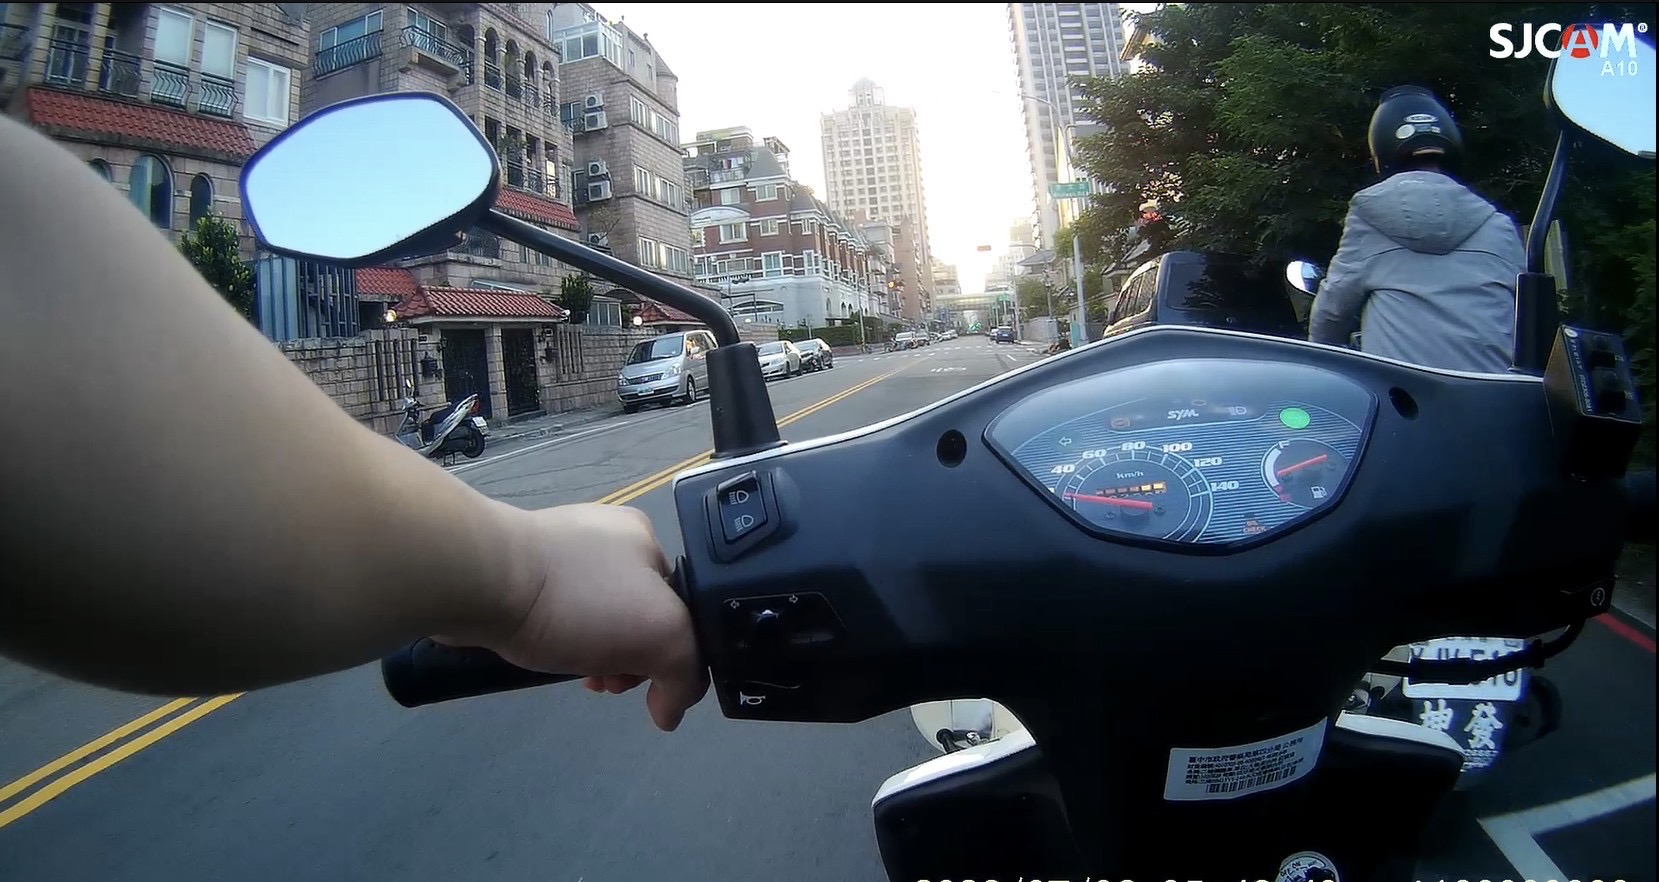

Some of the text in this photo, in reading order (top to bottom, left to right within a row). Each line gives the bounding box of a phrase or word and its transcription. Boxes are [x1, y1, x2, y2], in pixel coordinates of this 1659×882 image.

[1167, 408, 1199, 421] SYM
[1121, 440, 1146, 452] 80
[1162, 441, 1193, 453] 100
[1082, 448, 1107, 460] 60
[1193, 456, 1222, 468] 120
[1050, 463, 1075, 475] 40
[1211, 480, 1240, 491] 140
